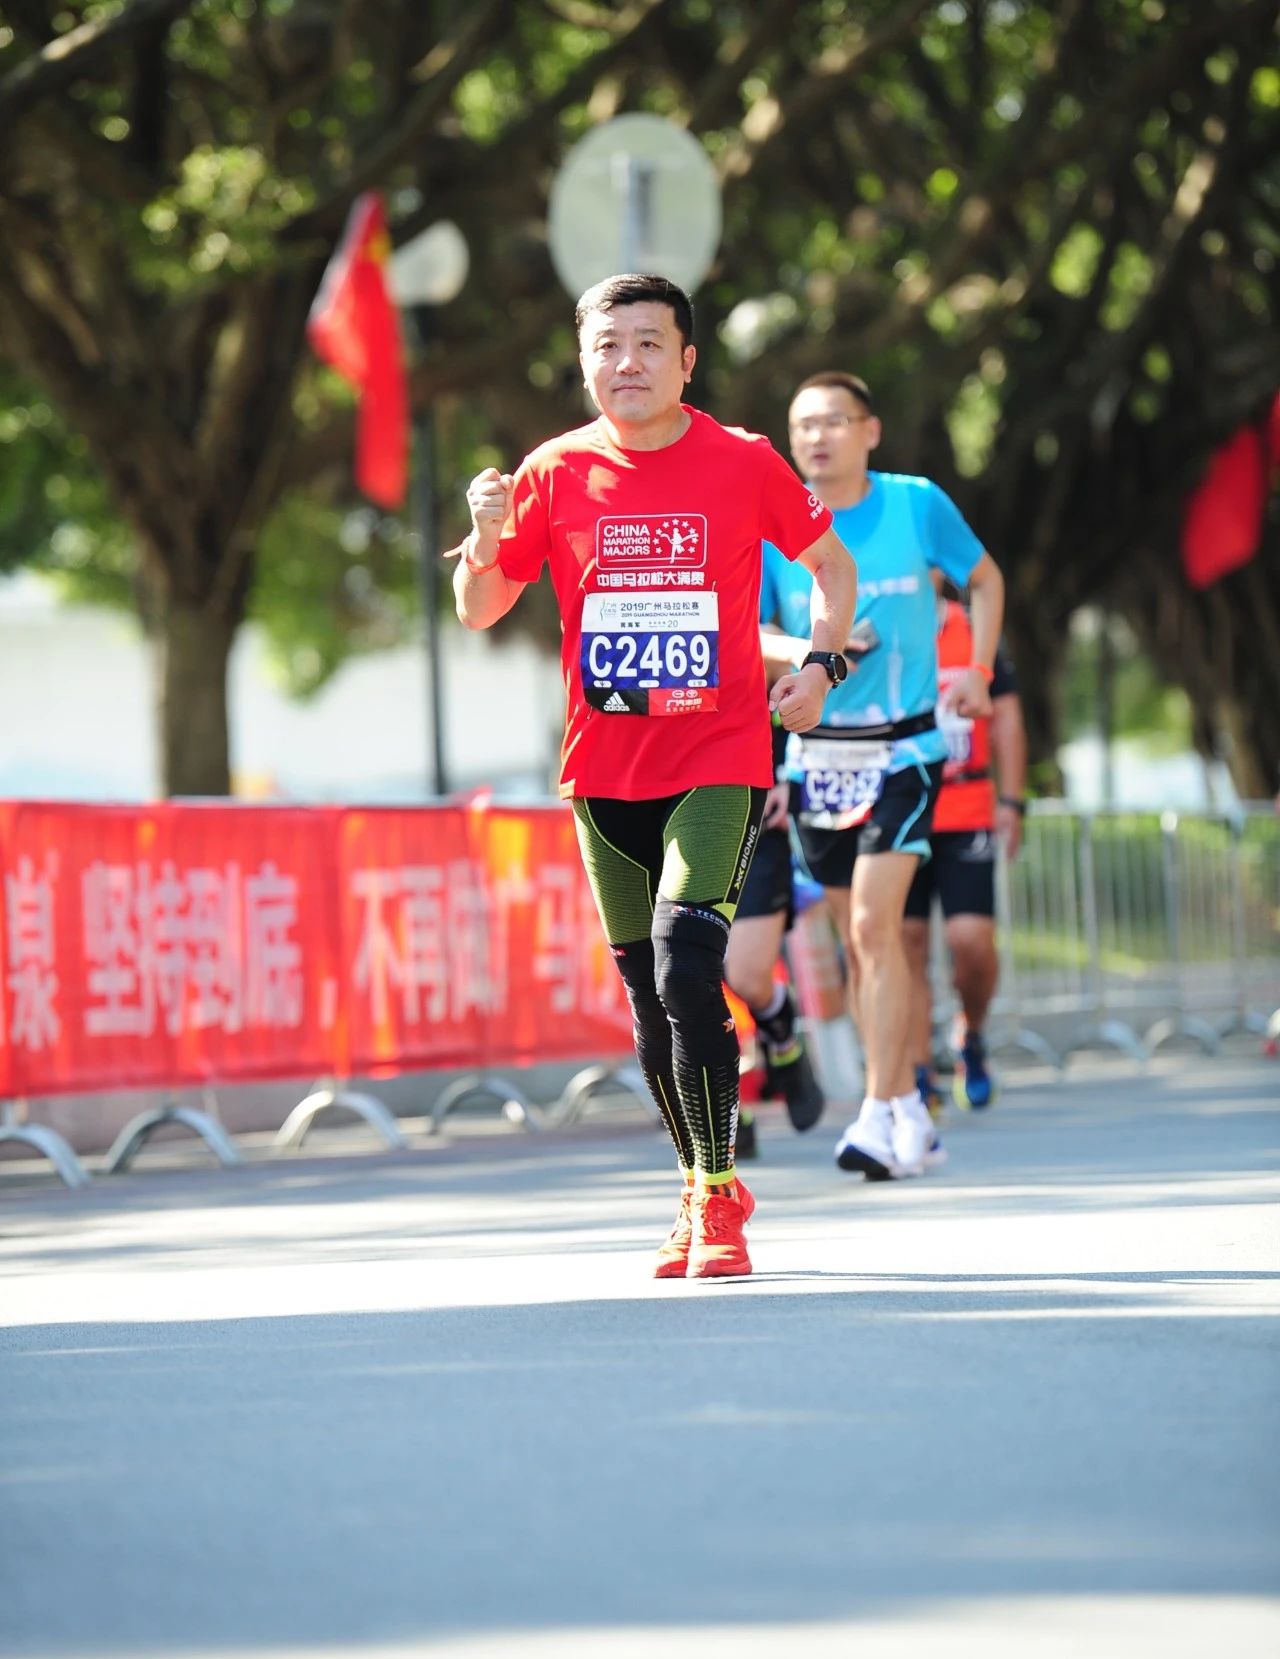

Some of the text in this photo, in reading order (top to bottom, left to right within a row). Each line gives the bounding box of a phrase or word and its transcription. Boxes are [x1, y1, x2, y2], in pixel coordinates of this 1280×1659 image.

[603, 524, 650, 537] CHINA
[603, 537, 650, 546] MARATHON
[603, 545, 650, 556] MAJORS
[620, 602, 699, 611] 2019广州马拉松赛
[589, 634, 710, 678] C2469
[603, 704, 630, 712] adidas
